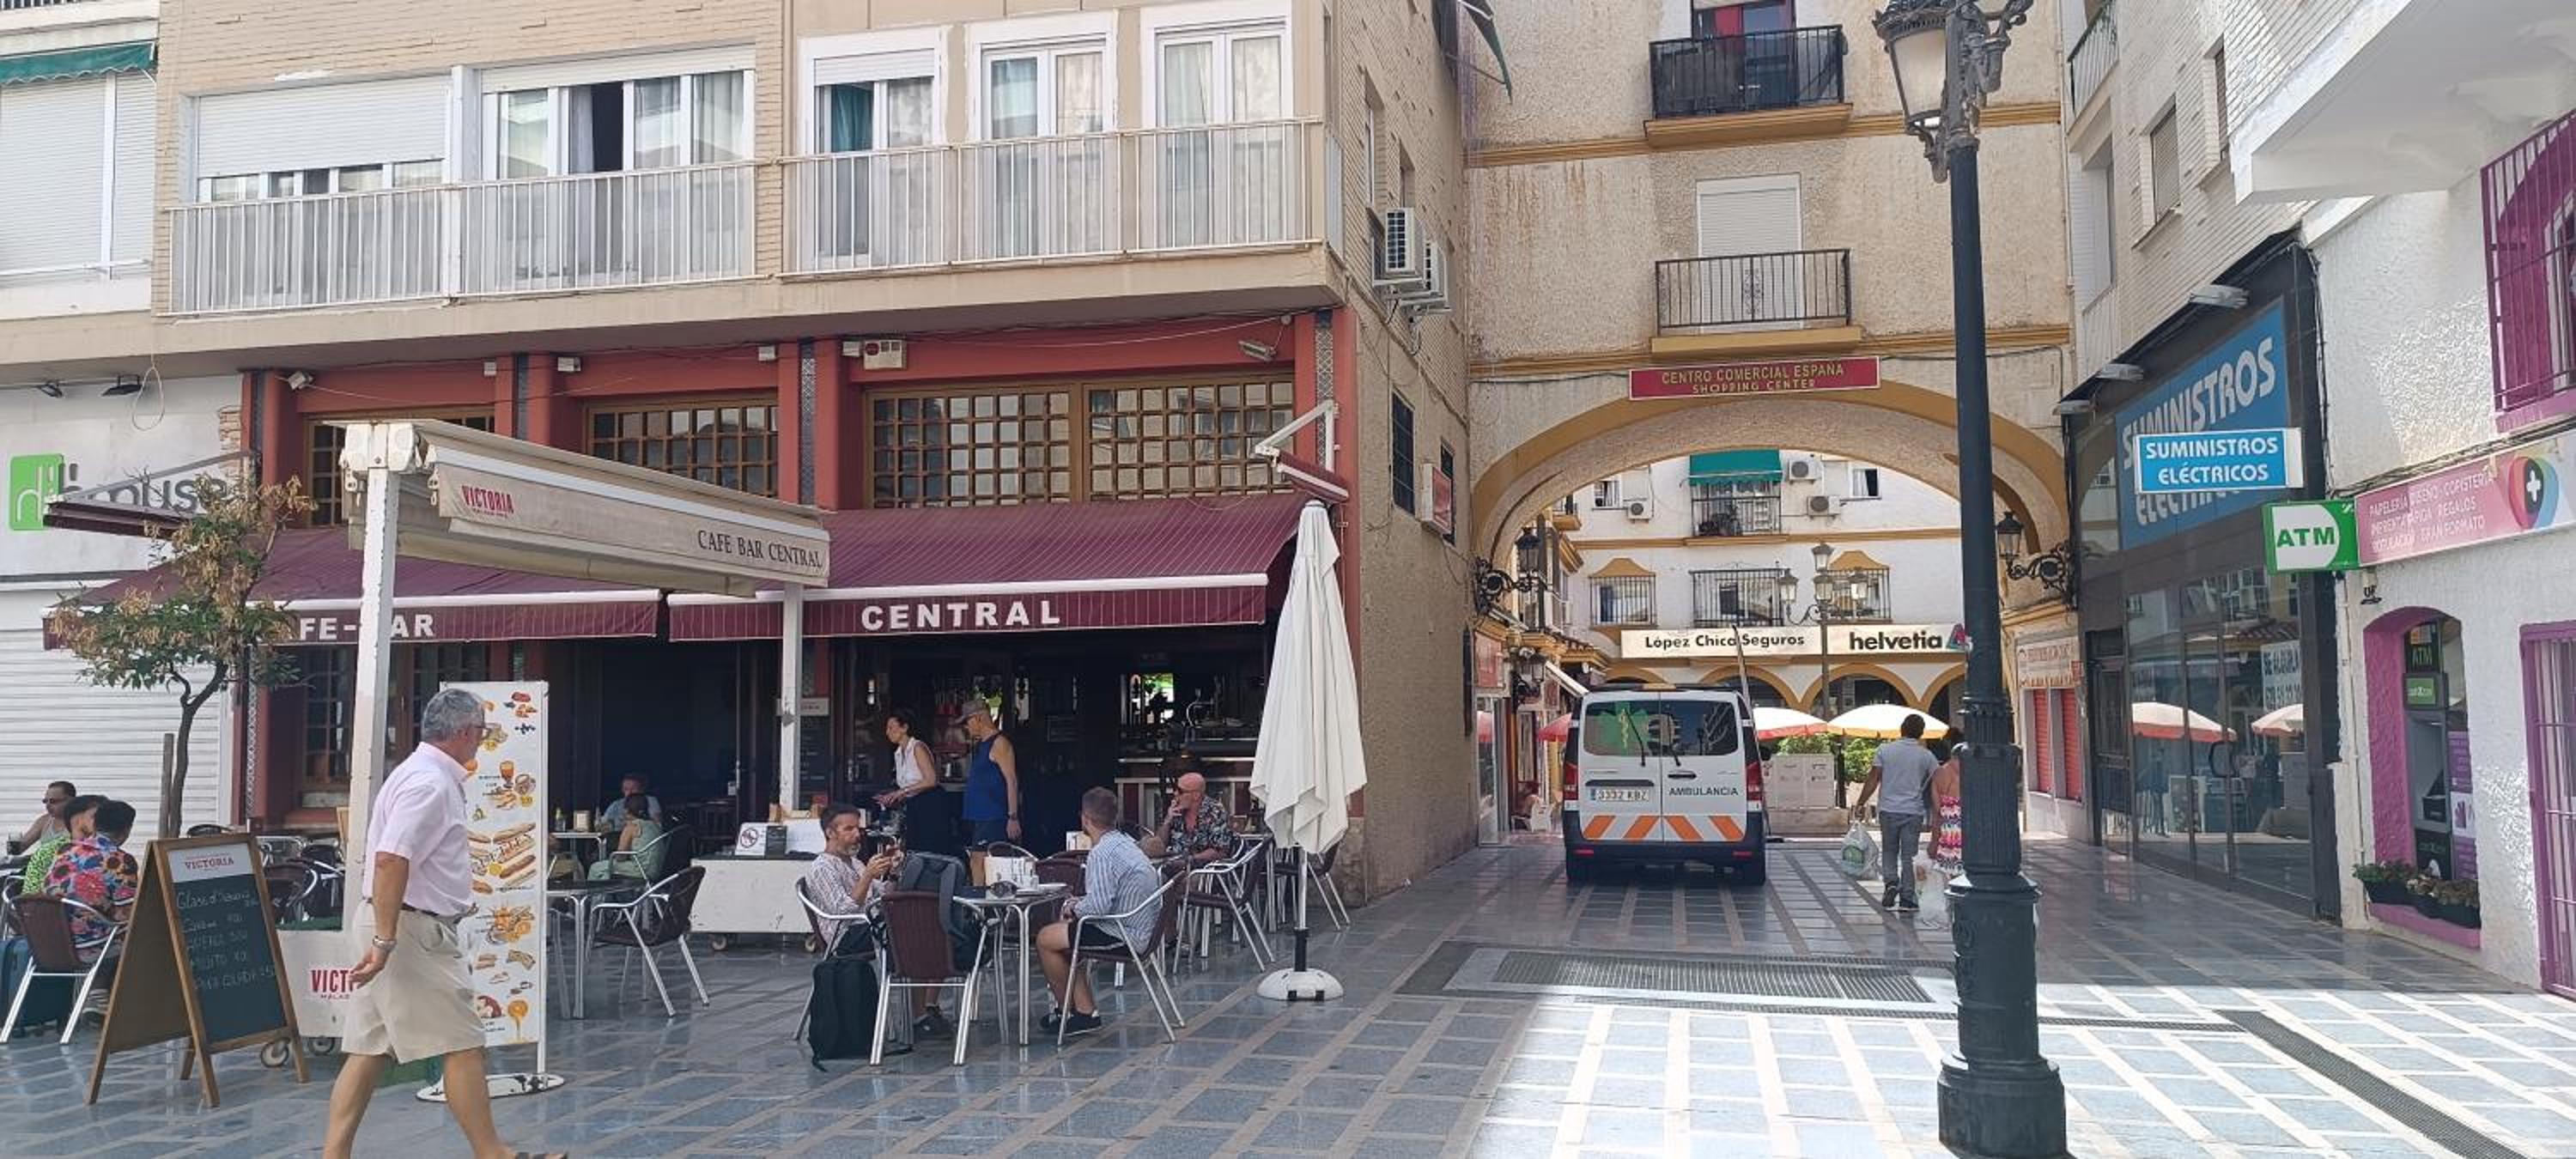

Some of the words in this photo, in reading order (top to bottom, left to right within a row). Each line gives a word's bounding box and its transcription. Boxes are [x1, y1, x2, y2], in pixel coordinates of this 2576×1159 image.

[1662, 370, 1712, 385] CENTRO
[1716, 366, 1790, 381] COMERCIAL
[1692, 383, 1759, 394] SHOPPING
[1766, 379, 1815, 391] CENTER
[2146, 437, 2279, 459] SUMINISTROS
[2158, 462, 2269, 485] ELÉCTRICOS
[461, 485, 514, 513] VICTORIA
[2276, 526, 2336, 548] ATM
[697, 530, 732, 554] CAFE
[737, 537, 763, 559] BAR
[769, 543, 823, 568] CENTRAL
[860, 600, 1061, 631] CENTRAL
[1644, 634, 1692, 649] López
[1741, 633, 1805, 650] Seguros
[1849, 631, 1943, 651] helvetia
[1668, 786, 1739, 797] AMBULANCIA
[185, 857, 234, 871] VICTORIA
